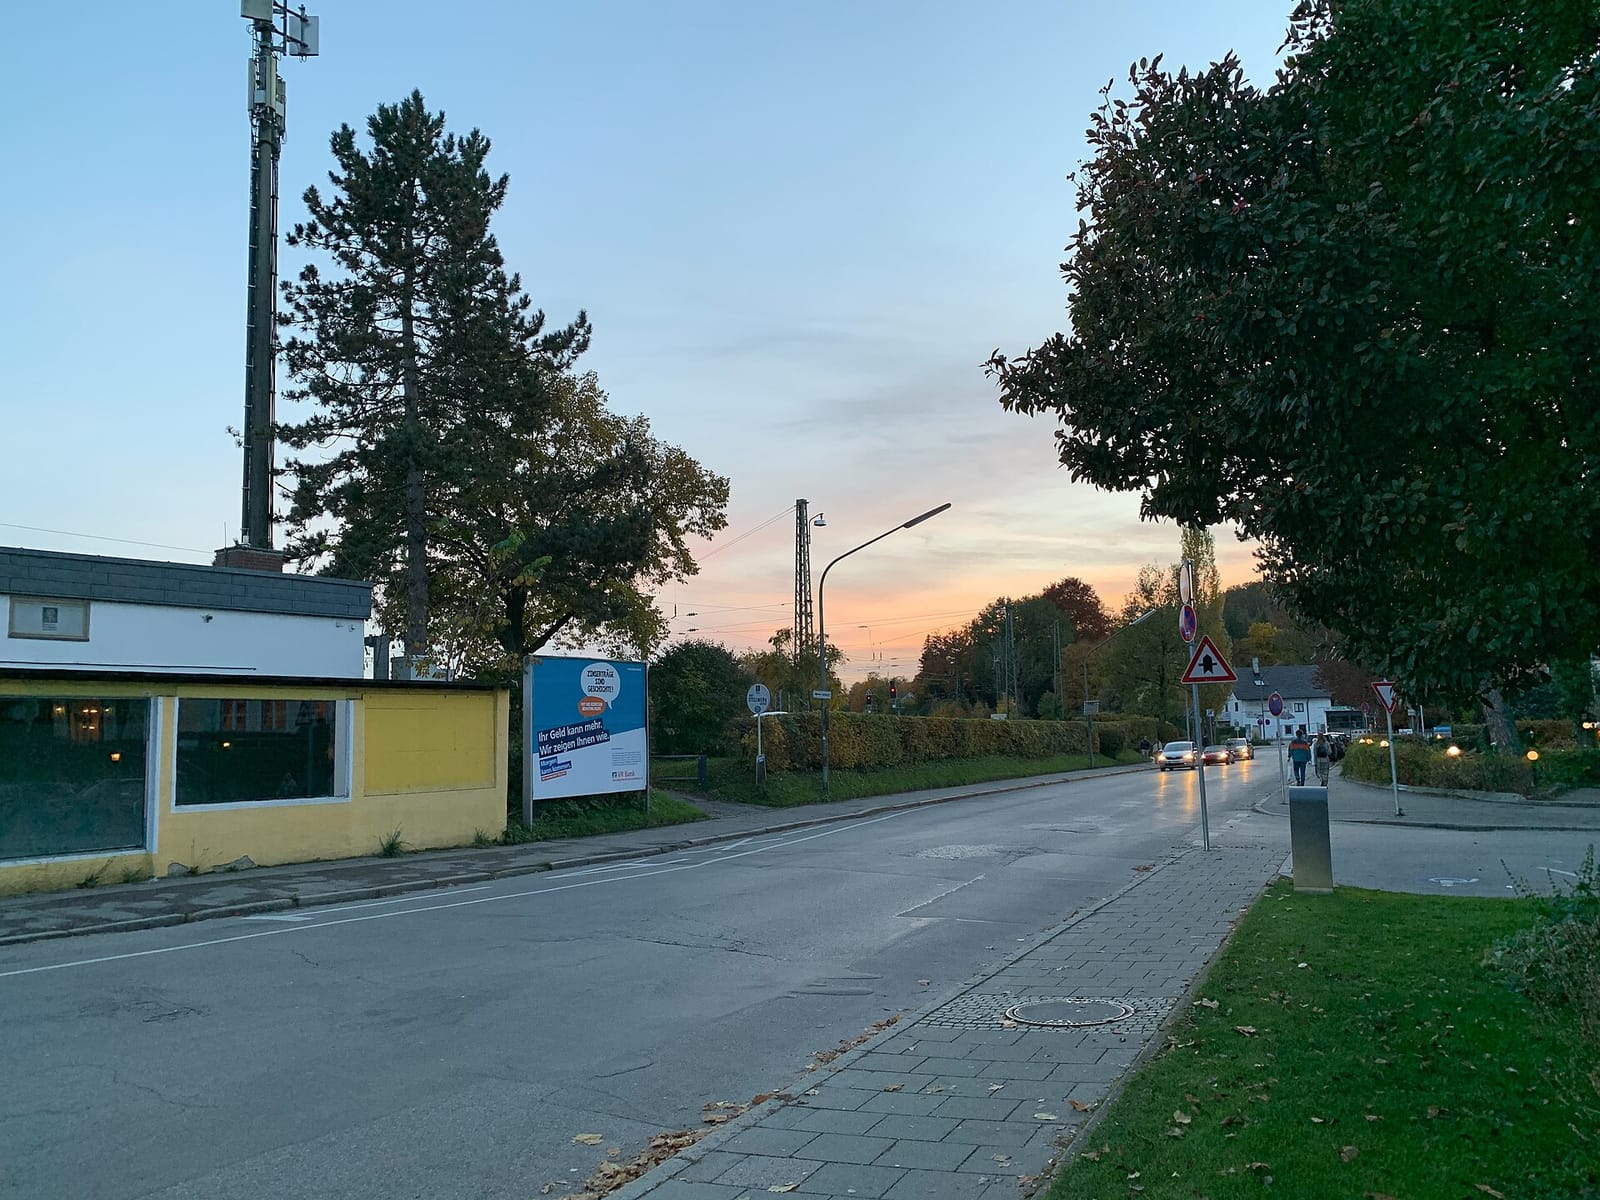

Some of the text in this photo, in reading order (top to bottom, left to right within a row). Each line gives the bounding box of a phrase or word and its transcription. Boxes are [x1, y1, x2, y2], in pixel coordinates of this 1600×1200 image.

[538, 719, 603, 743] Ihr Geld kann mehr.
[539, 731, 610, 756] Wir zeigen Ihnen wie.
